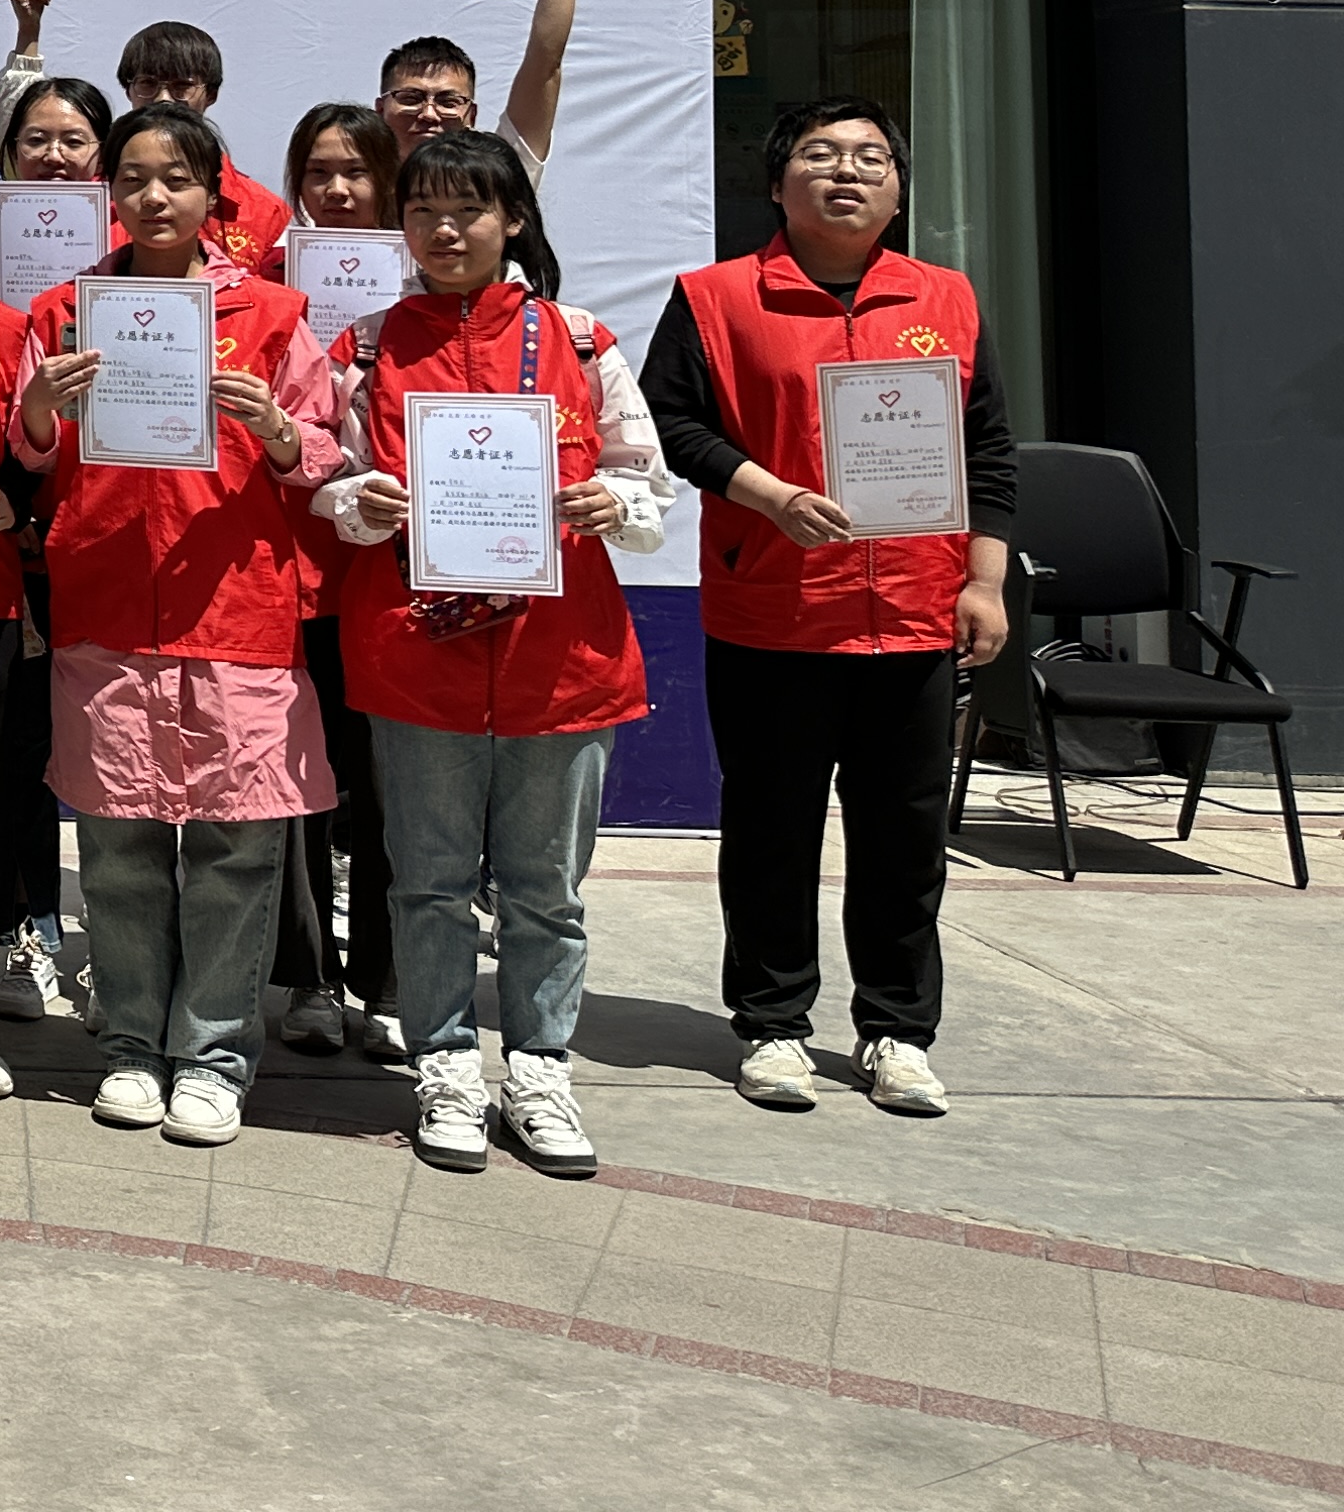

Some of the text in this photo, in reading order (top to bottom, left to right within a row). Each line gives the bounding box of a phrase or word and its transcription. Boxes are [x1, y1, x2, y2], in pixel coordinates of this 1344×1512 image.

[113, 328, 176, 343] 志愿者证书
[860, 409, 922, 423] 志愿者证书
[449, 447, 514, 462] 志愿者证书
